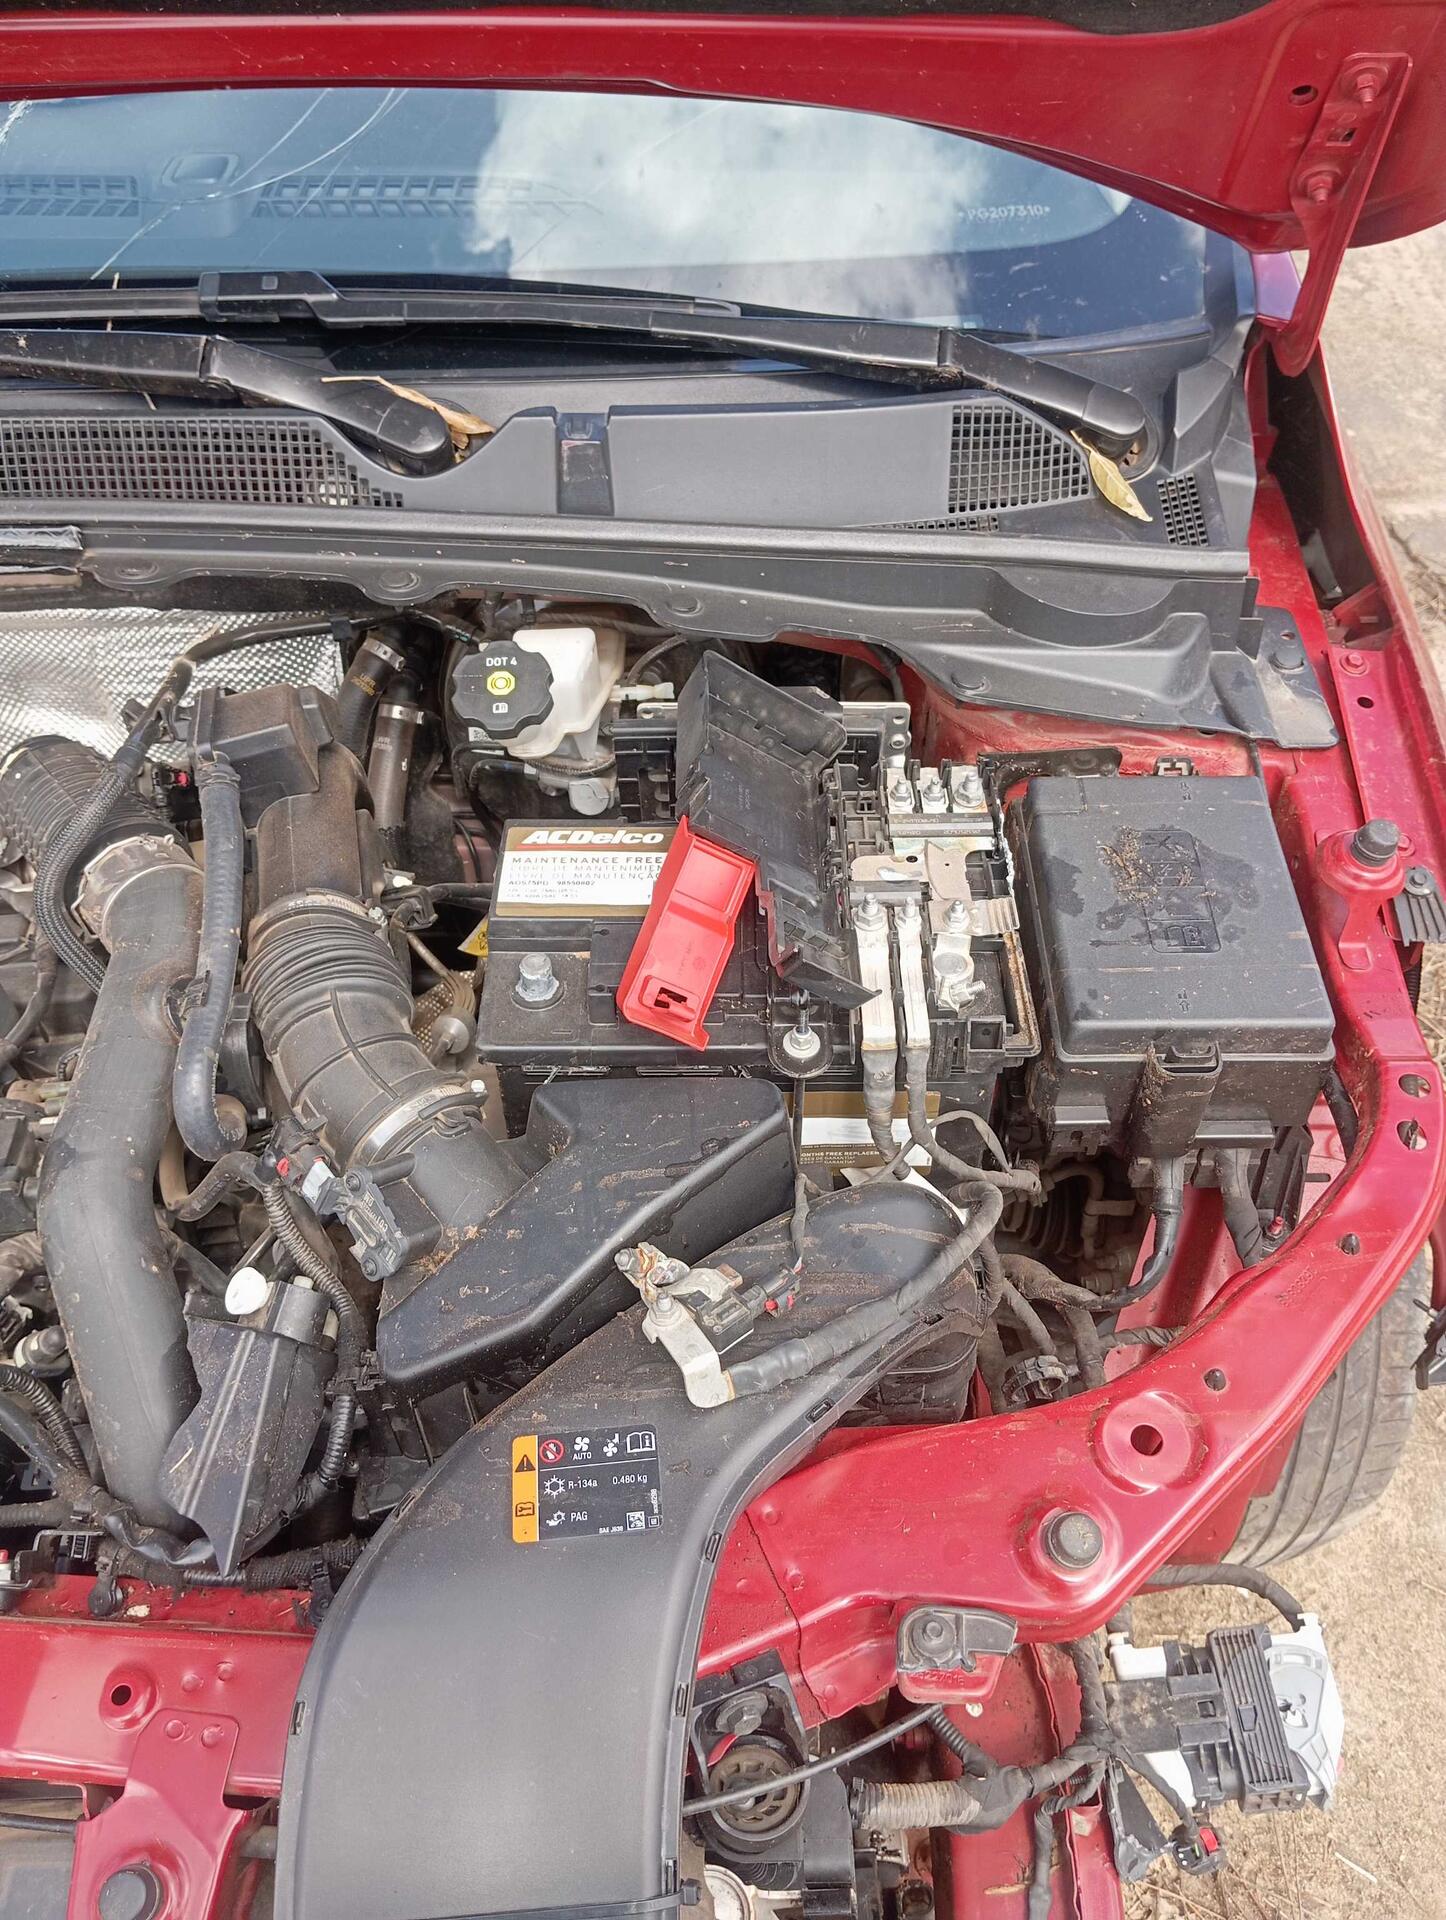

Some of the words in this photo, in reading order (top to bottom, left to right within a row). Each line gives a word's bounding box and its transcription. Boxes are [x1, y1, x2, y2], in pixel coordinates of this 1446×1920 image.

[485, 657, 508, 667] DOT
[510, 656, 518, 666] 4
[521, 830, 665, 845] ACDelco
[512, 856, 619, 864] MAINTENANCE
[625, 856, 663, 864] FREE
[574, 864, 662, 872] MANTENIMIEN
[572, 1451, 592, 1460] AUTO
[568, 1479, 598, 1490] R-134a
[612, 1474, 636, 1485] 0.480
[637, 1473, 648, 1484] kg
[570, 1511, 588, 1522] PAG
